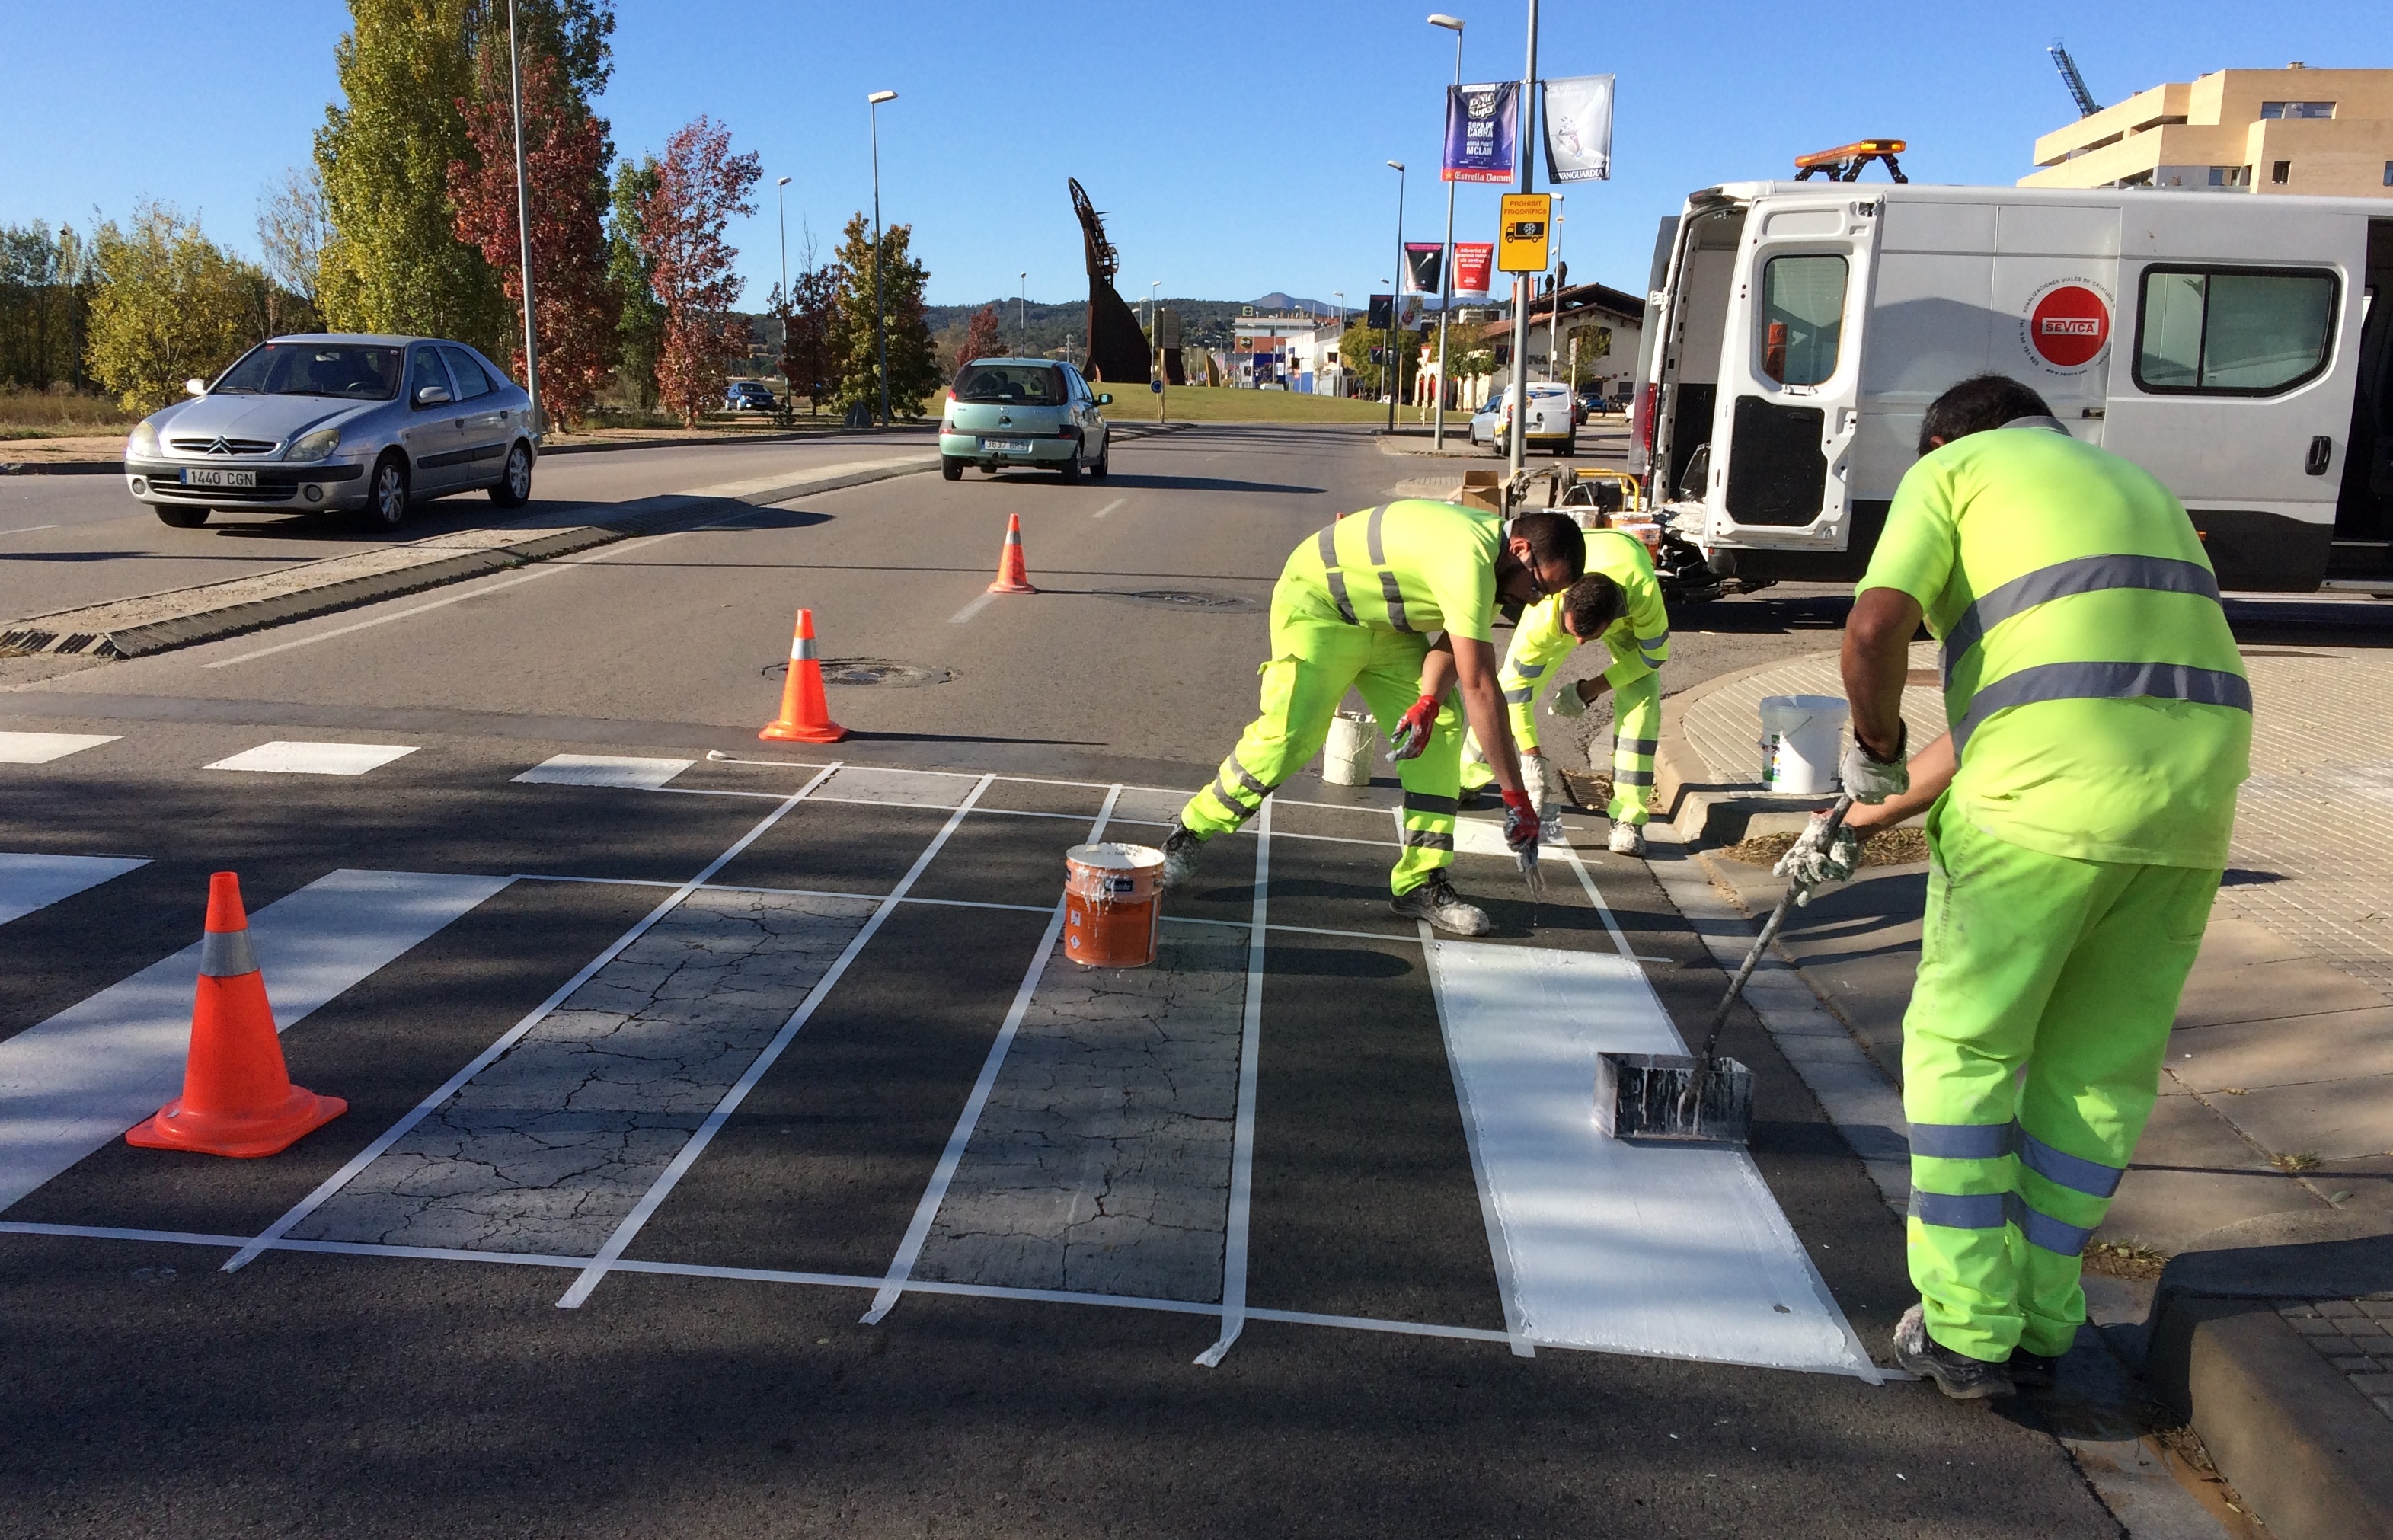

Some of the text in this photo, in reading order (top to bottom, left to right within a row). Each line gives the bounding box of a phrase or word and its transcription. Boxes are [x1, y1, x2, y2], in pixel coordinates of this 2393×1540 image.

[1469, 106, 1494, 117] Sopa
[1468, 121, 1494, 129] SOPA DE
[1467, 127, 1494, 138] CABRA
[1455, 171, 1512, 182] Estrella Damm
[2045, 320, 2096, 333] SEVICA
[986, 439, 1025, 449] 3637 BRS
[190, 471, 253, 486] 1440 CGN
